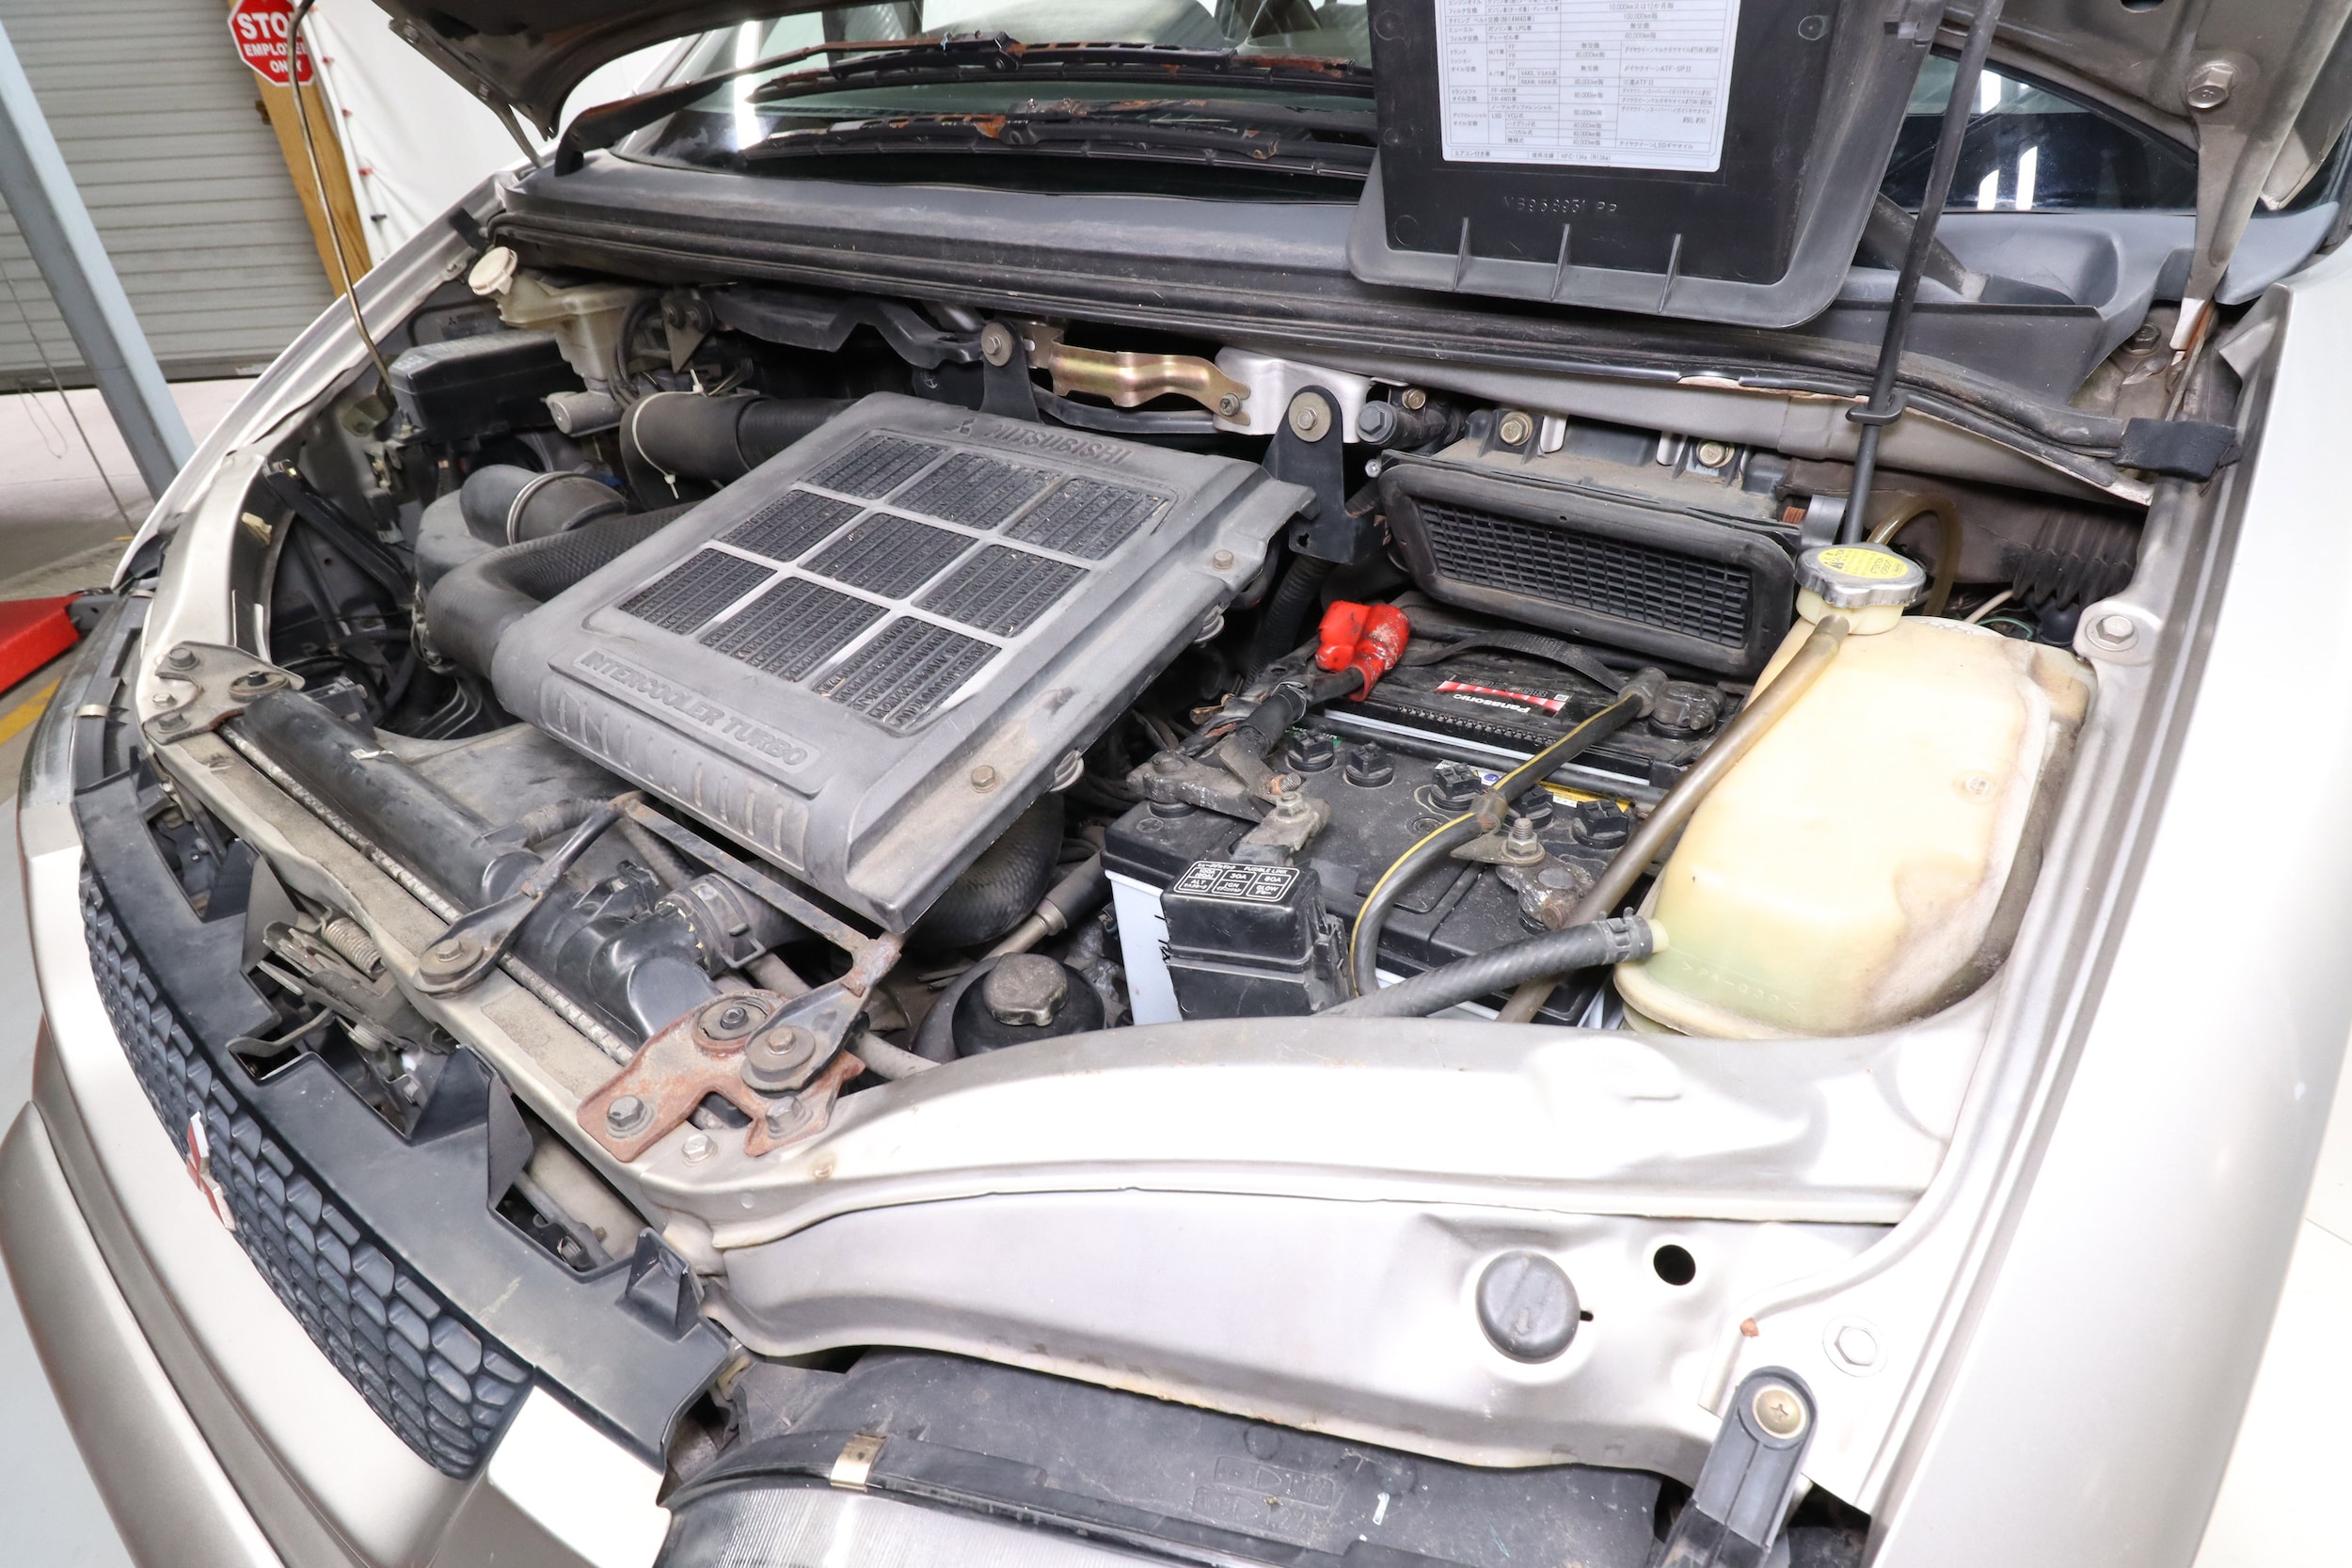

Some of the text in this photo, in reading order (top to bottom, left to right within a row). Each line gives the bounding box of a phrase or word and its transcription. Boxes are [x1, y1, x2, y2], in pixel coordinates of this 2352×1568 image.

[984, 424, 1133, 465] MITSUBISHI
[580, 650, 809, 766] INTERCOOLER TURBO
[1453, 693, 1532, 714] Panasonic
